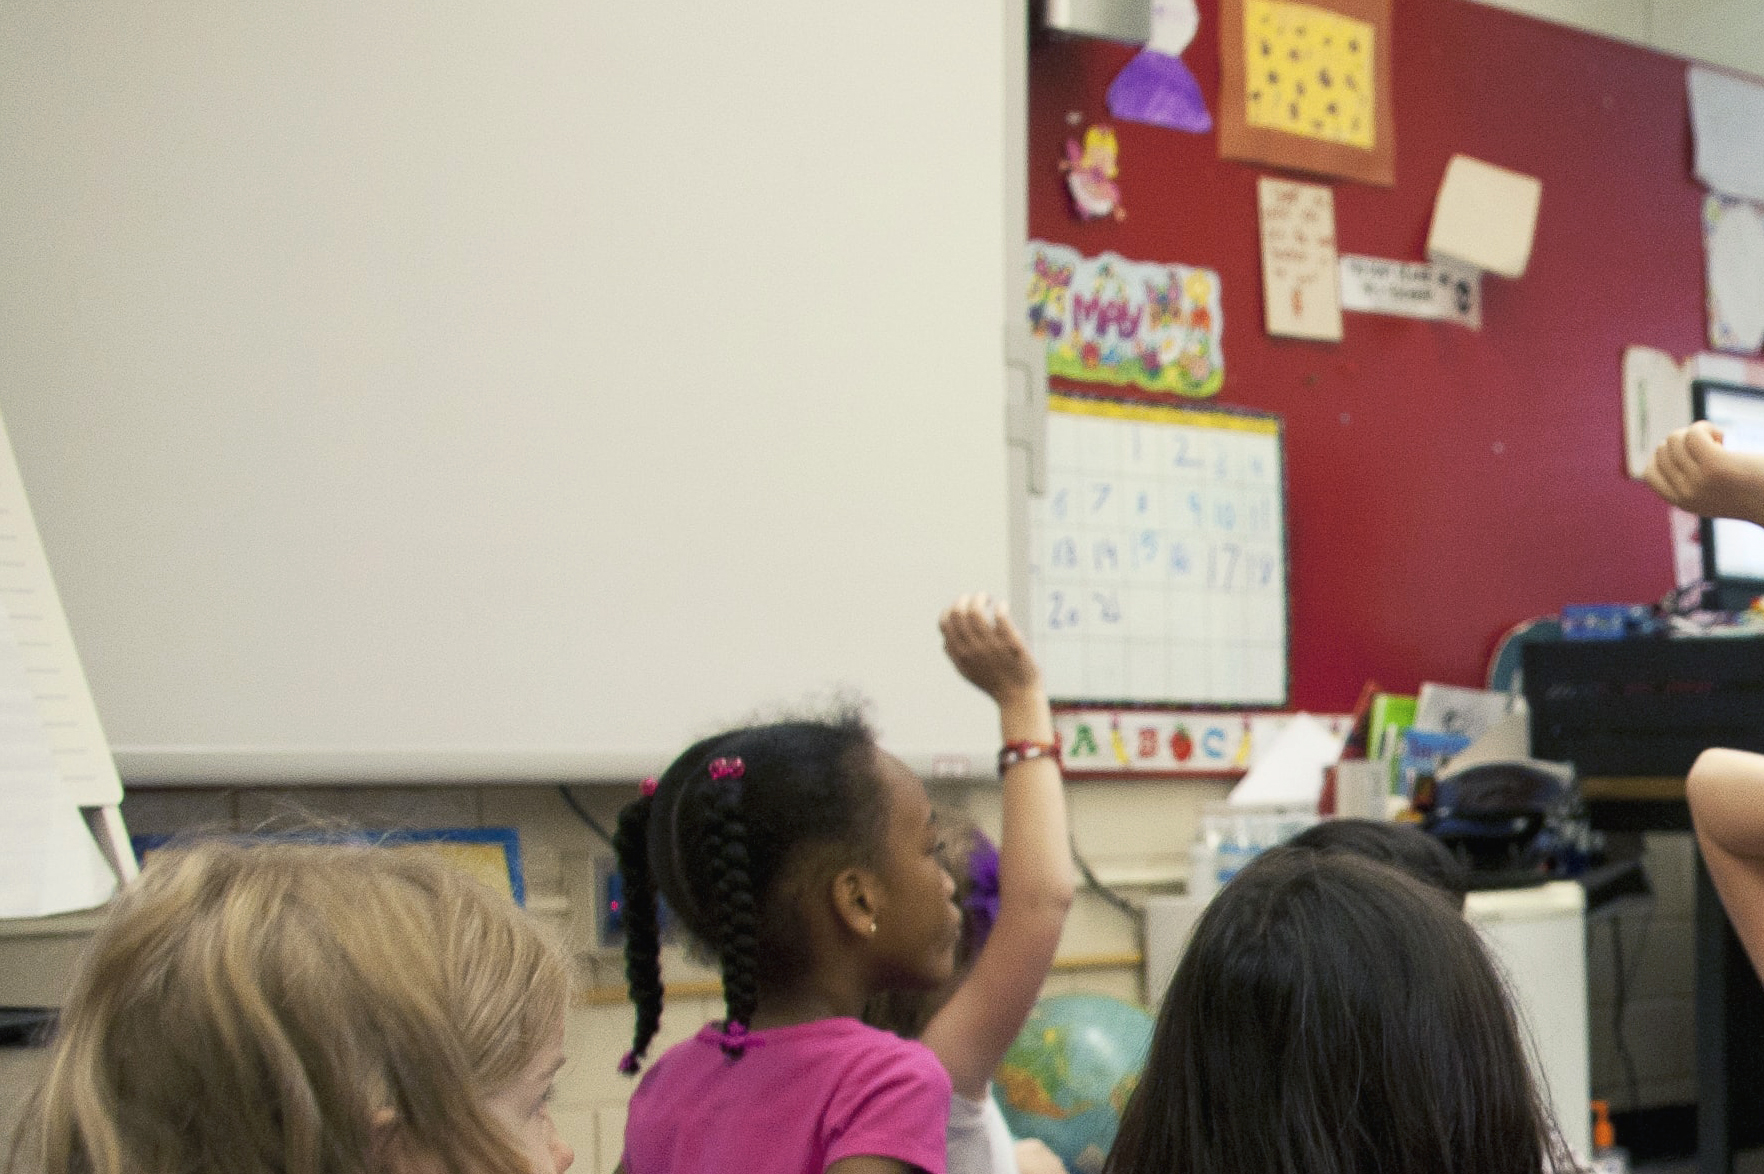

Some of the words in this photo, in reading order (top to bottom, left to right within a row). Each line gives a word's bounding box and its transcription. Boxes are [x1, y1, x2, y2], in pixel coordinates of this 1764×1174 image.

[1173, 433, 1205, 468] 2
[1091, 482, 1112, 514] 7
[1069, 724, 1098, 757] A
[1138, 726, 1160, 759] B
[1203, 726, 1227, 759] C
